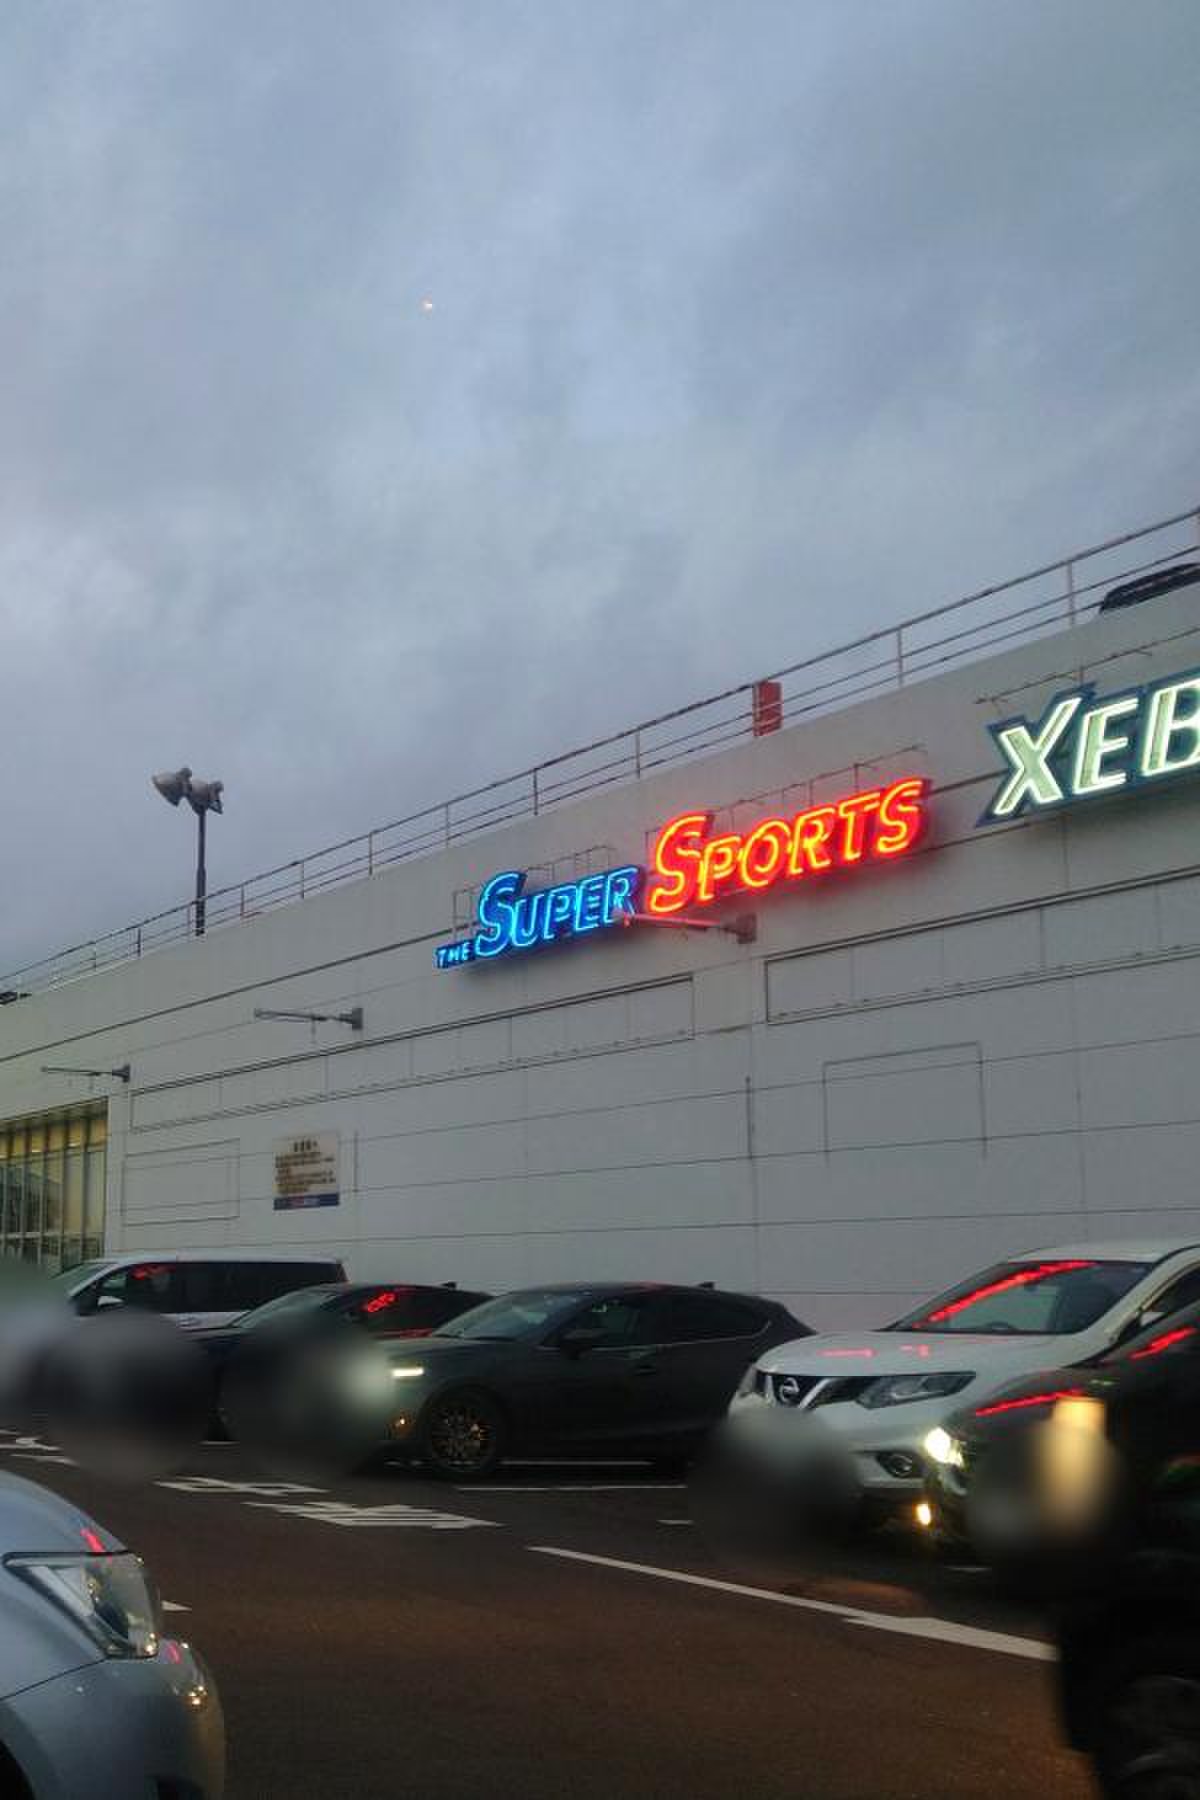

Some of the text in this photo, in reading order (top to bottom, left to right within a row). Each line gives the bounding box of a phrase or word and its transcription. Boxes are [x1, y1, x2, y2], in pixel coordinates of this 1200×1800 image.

[434, 778, 926, 969] THE SUPER SPORTS
